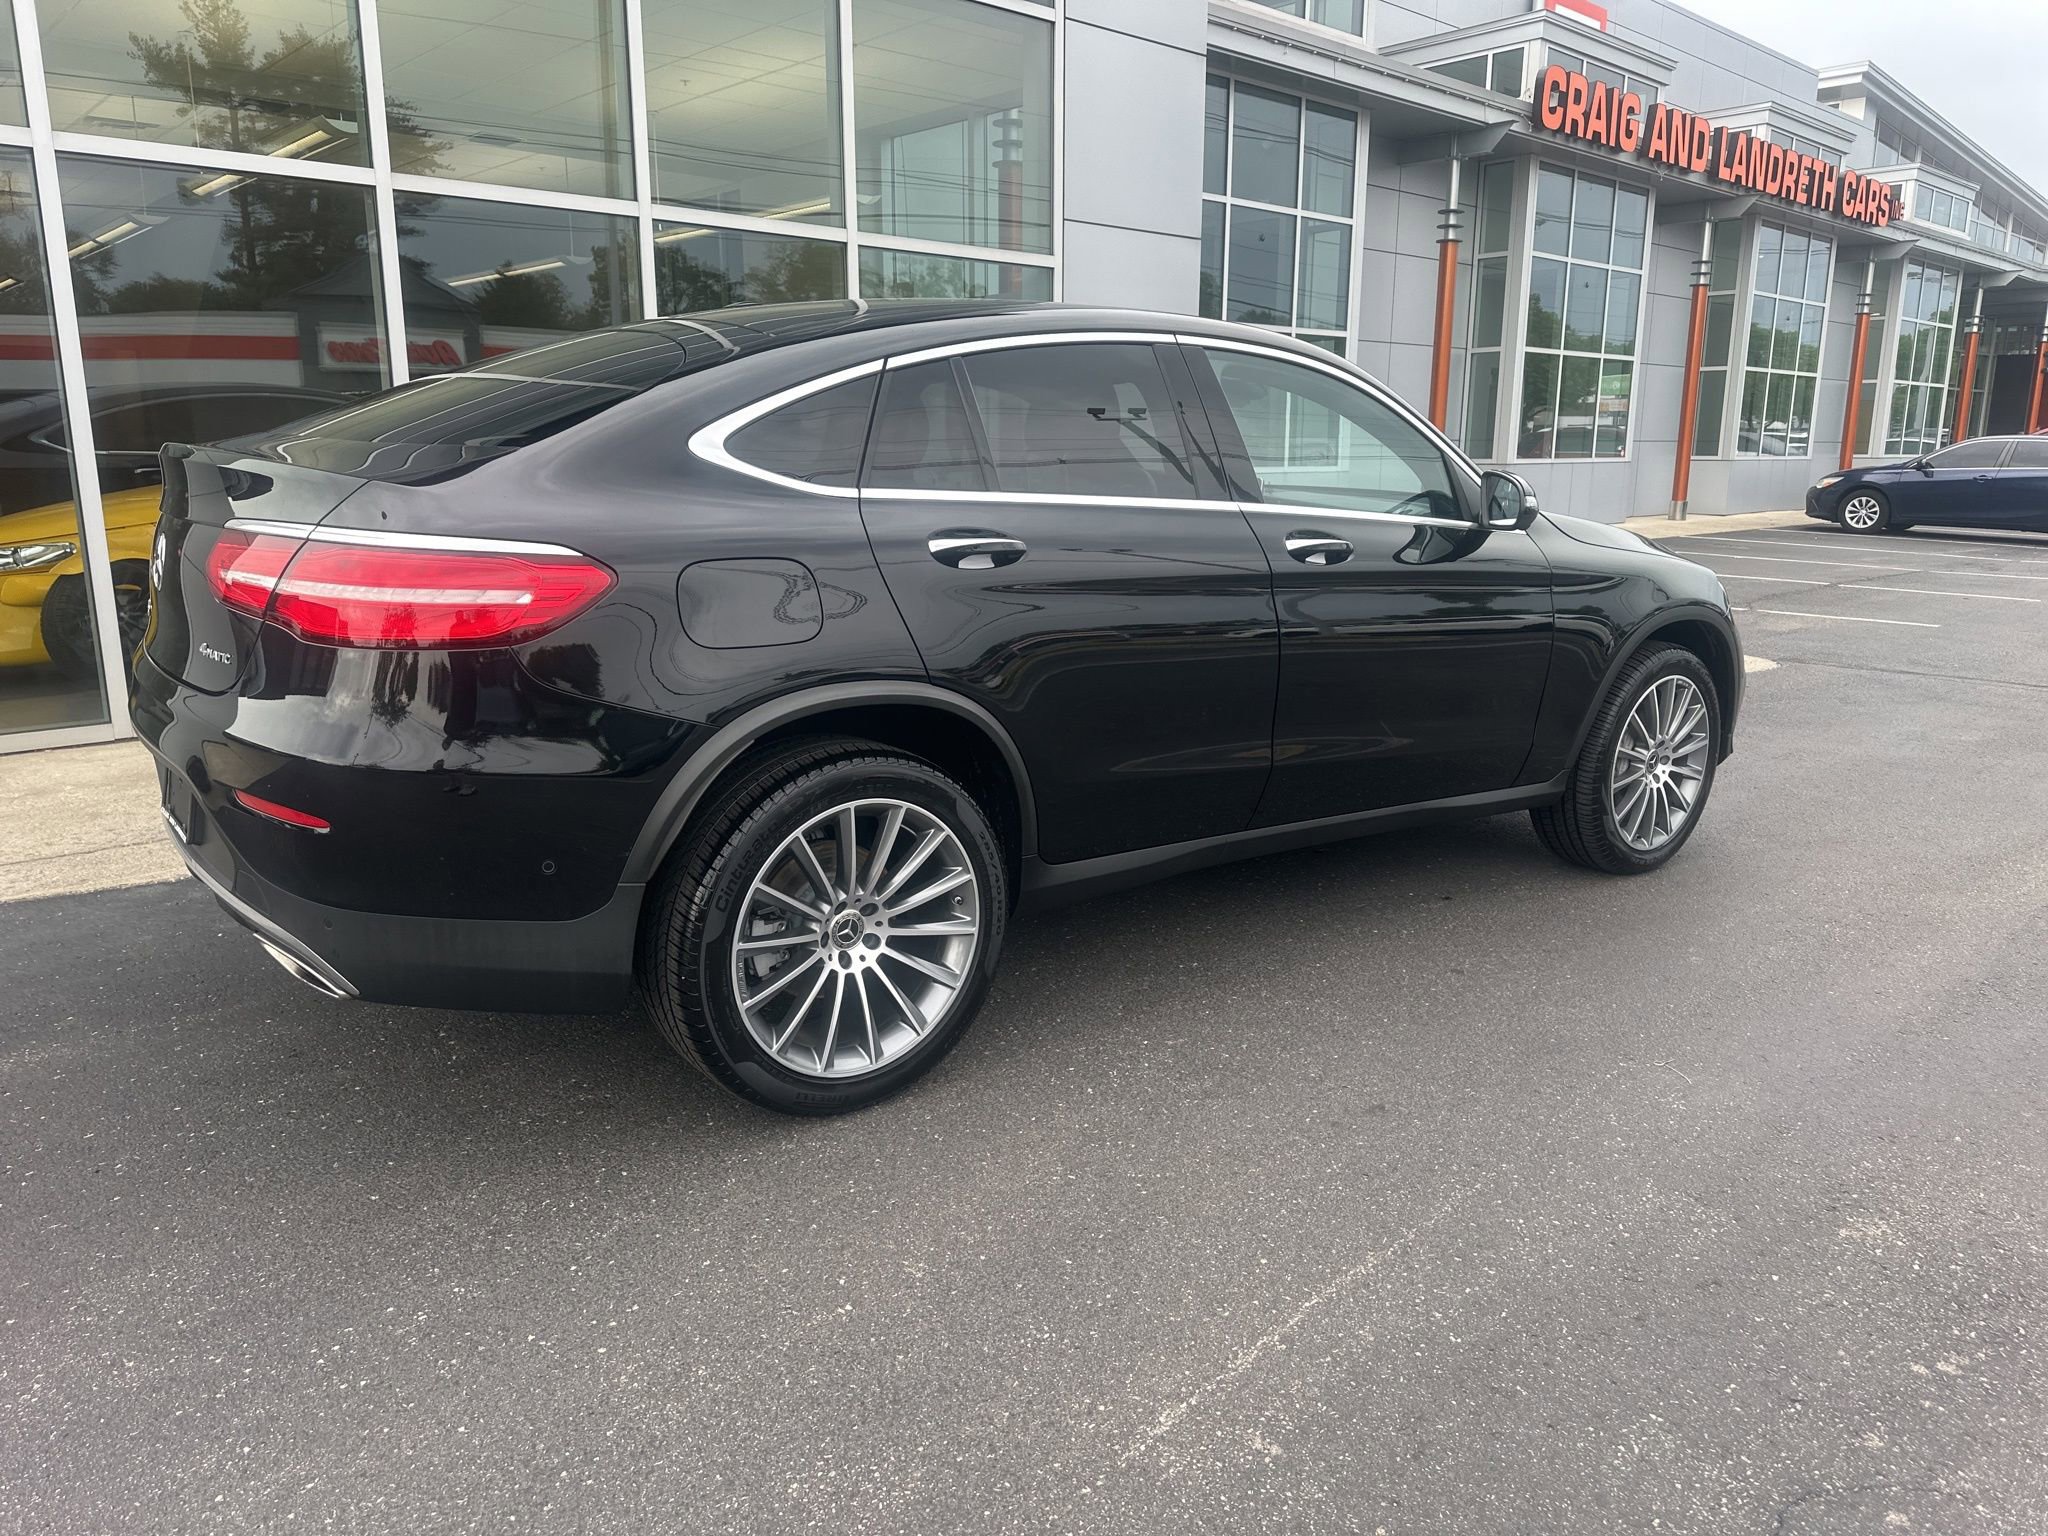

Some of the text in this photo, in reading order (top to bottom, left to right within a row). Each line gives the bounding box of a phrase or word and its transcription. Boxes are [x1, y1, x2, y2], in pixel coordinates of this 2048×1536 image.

[1540, 64, 1642, 153] CRAIG
[1648, 102, 1711, 173] AND
[1717, 126, 1839, 212] LANDRETH
[1841, 169, 1892, 228] CARS
[199, 642, 231, 664] 4MATIC
